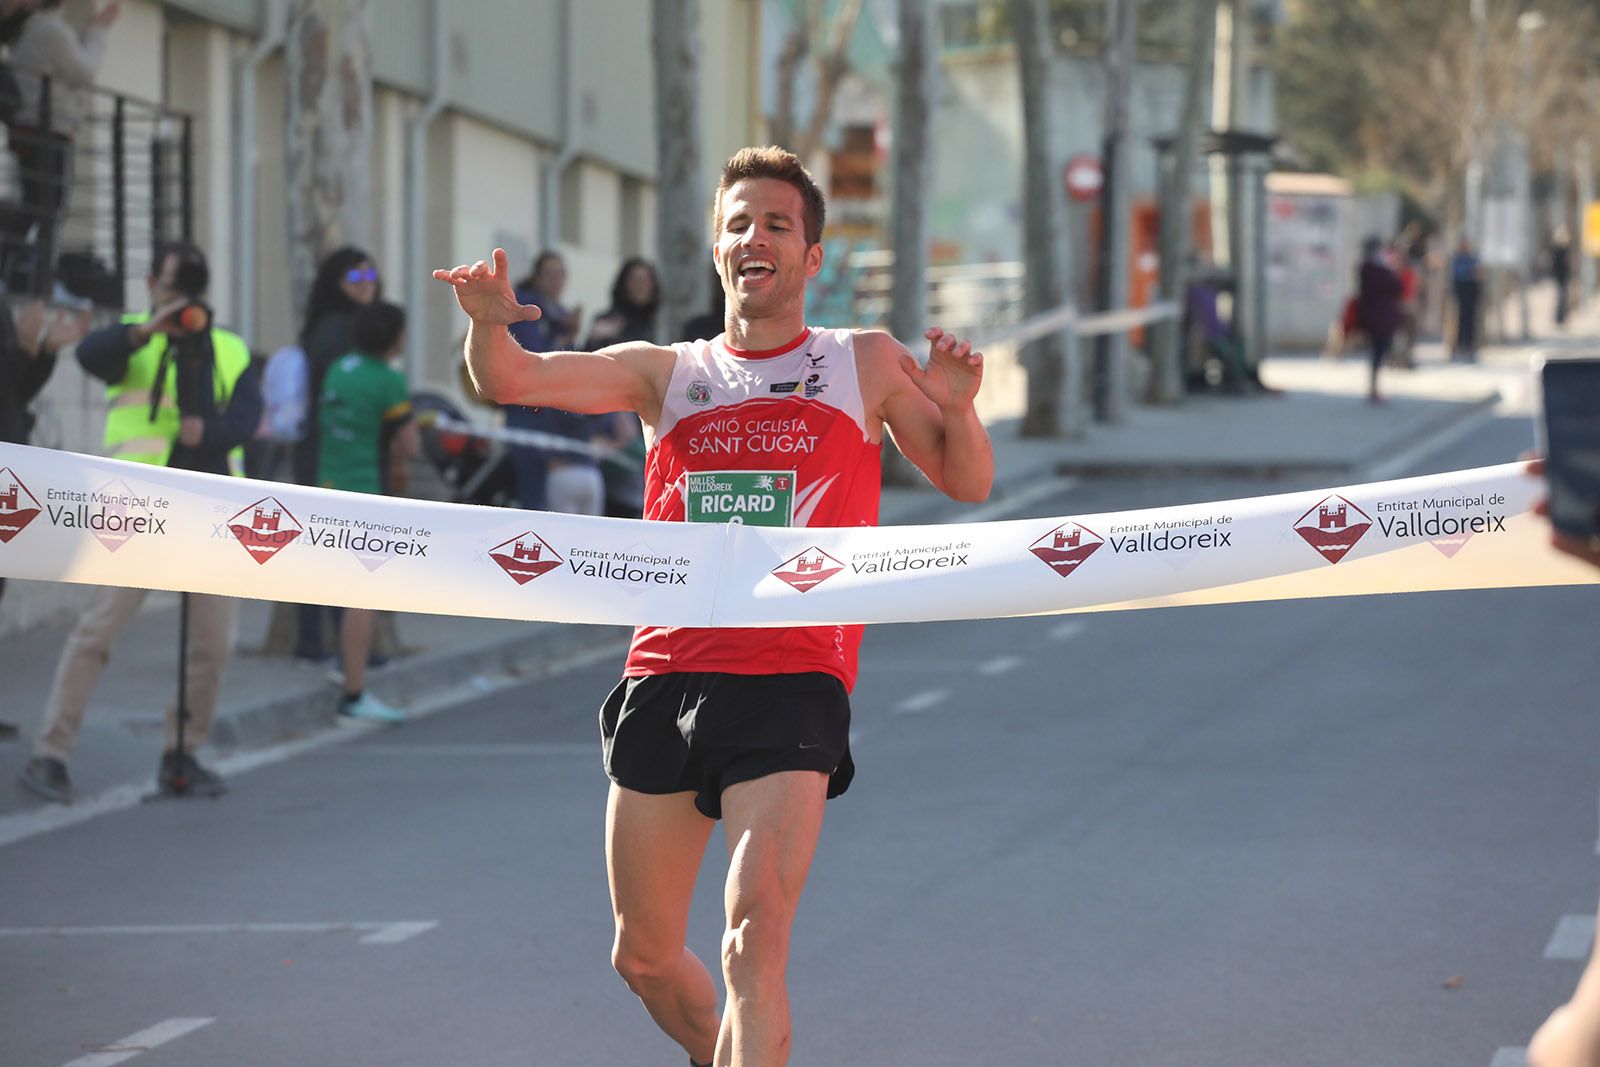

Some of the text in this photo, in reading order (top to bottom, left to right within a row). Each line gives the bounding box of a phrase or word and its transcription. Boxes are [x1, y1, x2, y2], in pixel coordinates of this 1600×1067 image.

[699, 417, 808, 433] UNIÓ CICLISTA
[689, 435, 818, 455] SANT CUGAT
[689, 475, 715, 486] MILLES
[690, 483, 732, 493] VALLDOREIX
[47, 488, 169, 508] Entitat Municipal de
[701, 494, 775, 513] RICARD
[1377, 493, 1505, 512] Entitat Municipal de
[47, 504, 166, 535] Valldoreix
[310, 514, 432, 538] Entitat Municipal de
[1110, 515, 1232, 534] Entitat Municipal de
[1377, 510, 1506, 538] Valldoreix
[309, 526, 428, 558] Valldoreix
[852, 541, 971, 561] Entitat Municipal de
[1110, 528, 1232, 554] Valldoreix
[570, 548, 691, 567] Entitat Municipal de
[851, 553, 969, 574] Valldoreix
[569, 559, 688, 585] Valldoreix
